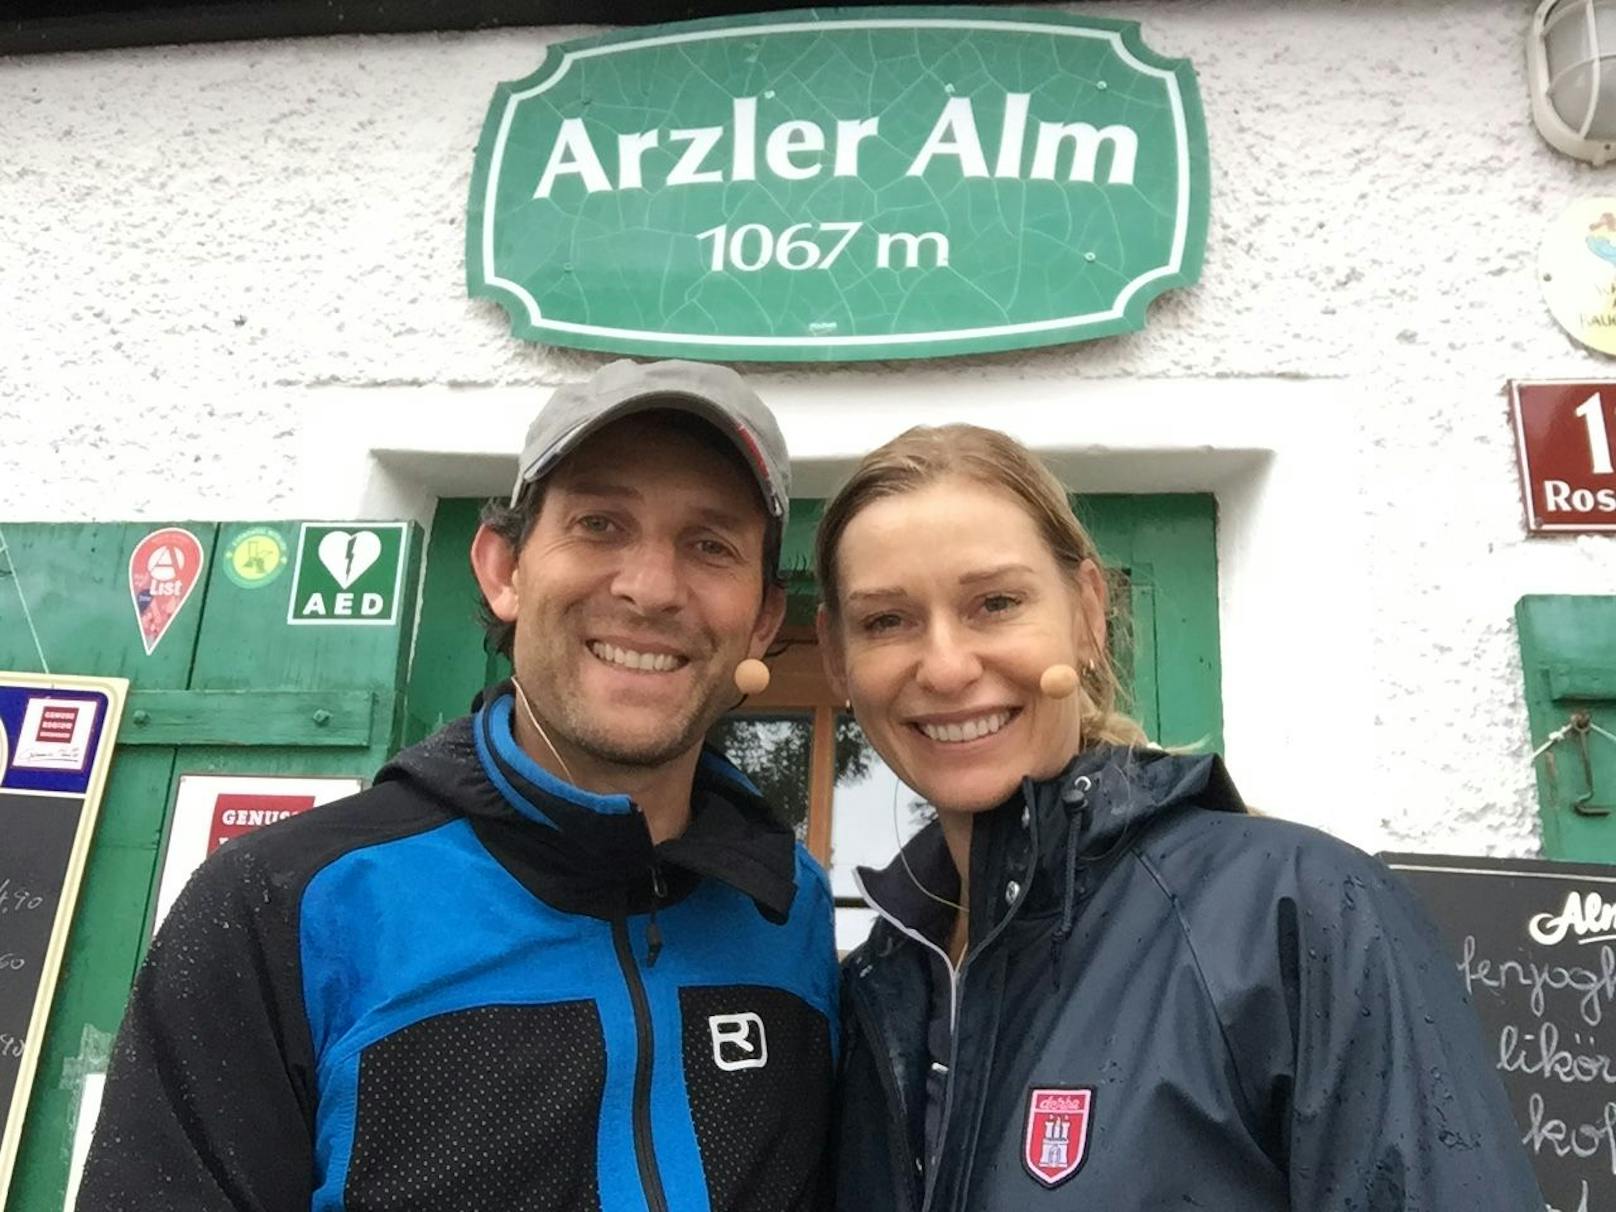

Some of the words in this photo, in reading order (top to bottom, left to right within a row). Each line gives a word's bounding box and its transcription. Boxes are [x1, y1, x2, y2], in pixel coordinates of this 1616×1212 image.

[533, 98, 879, 200] Arzler
[906, 93, 1139, 186] Alm
[696, 222, 863, 272] 1067
[877, 231, 950, 269] m
[1573, 391, 1616, 475] 1
[1543, 479, 1616, 513] Ros
[149, 578, 183, 596] List
[302, 591, 385, 616] AED
[221, 809, 300, 826] GENUS
